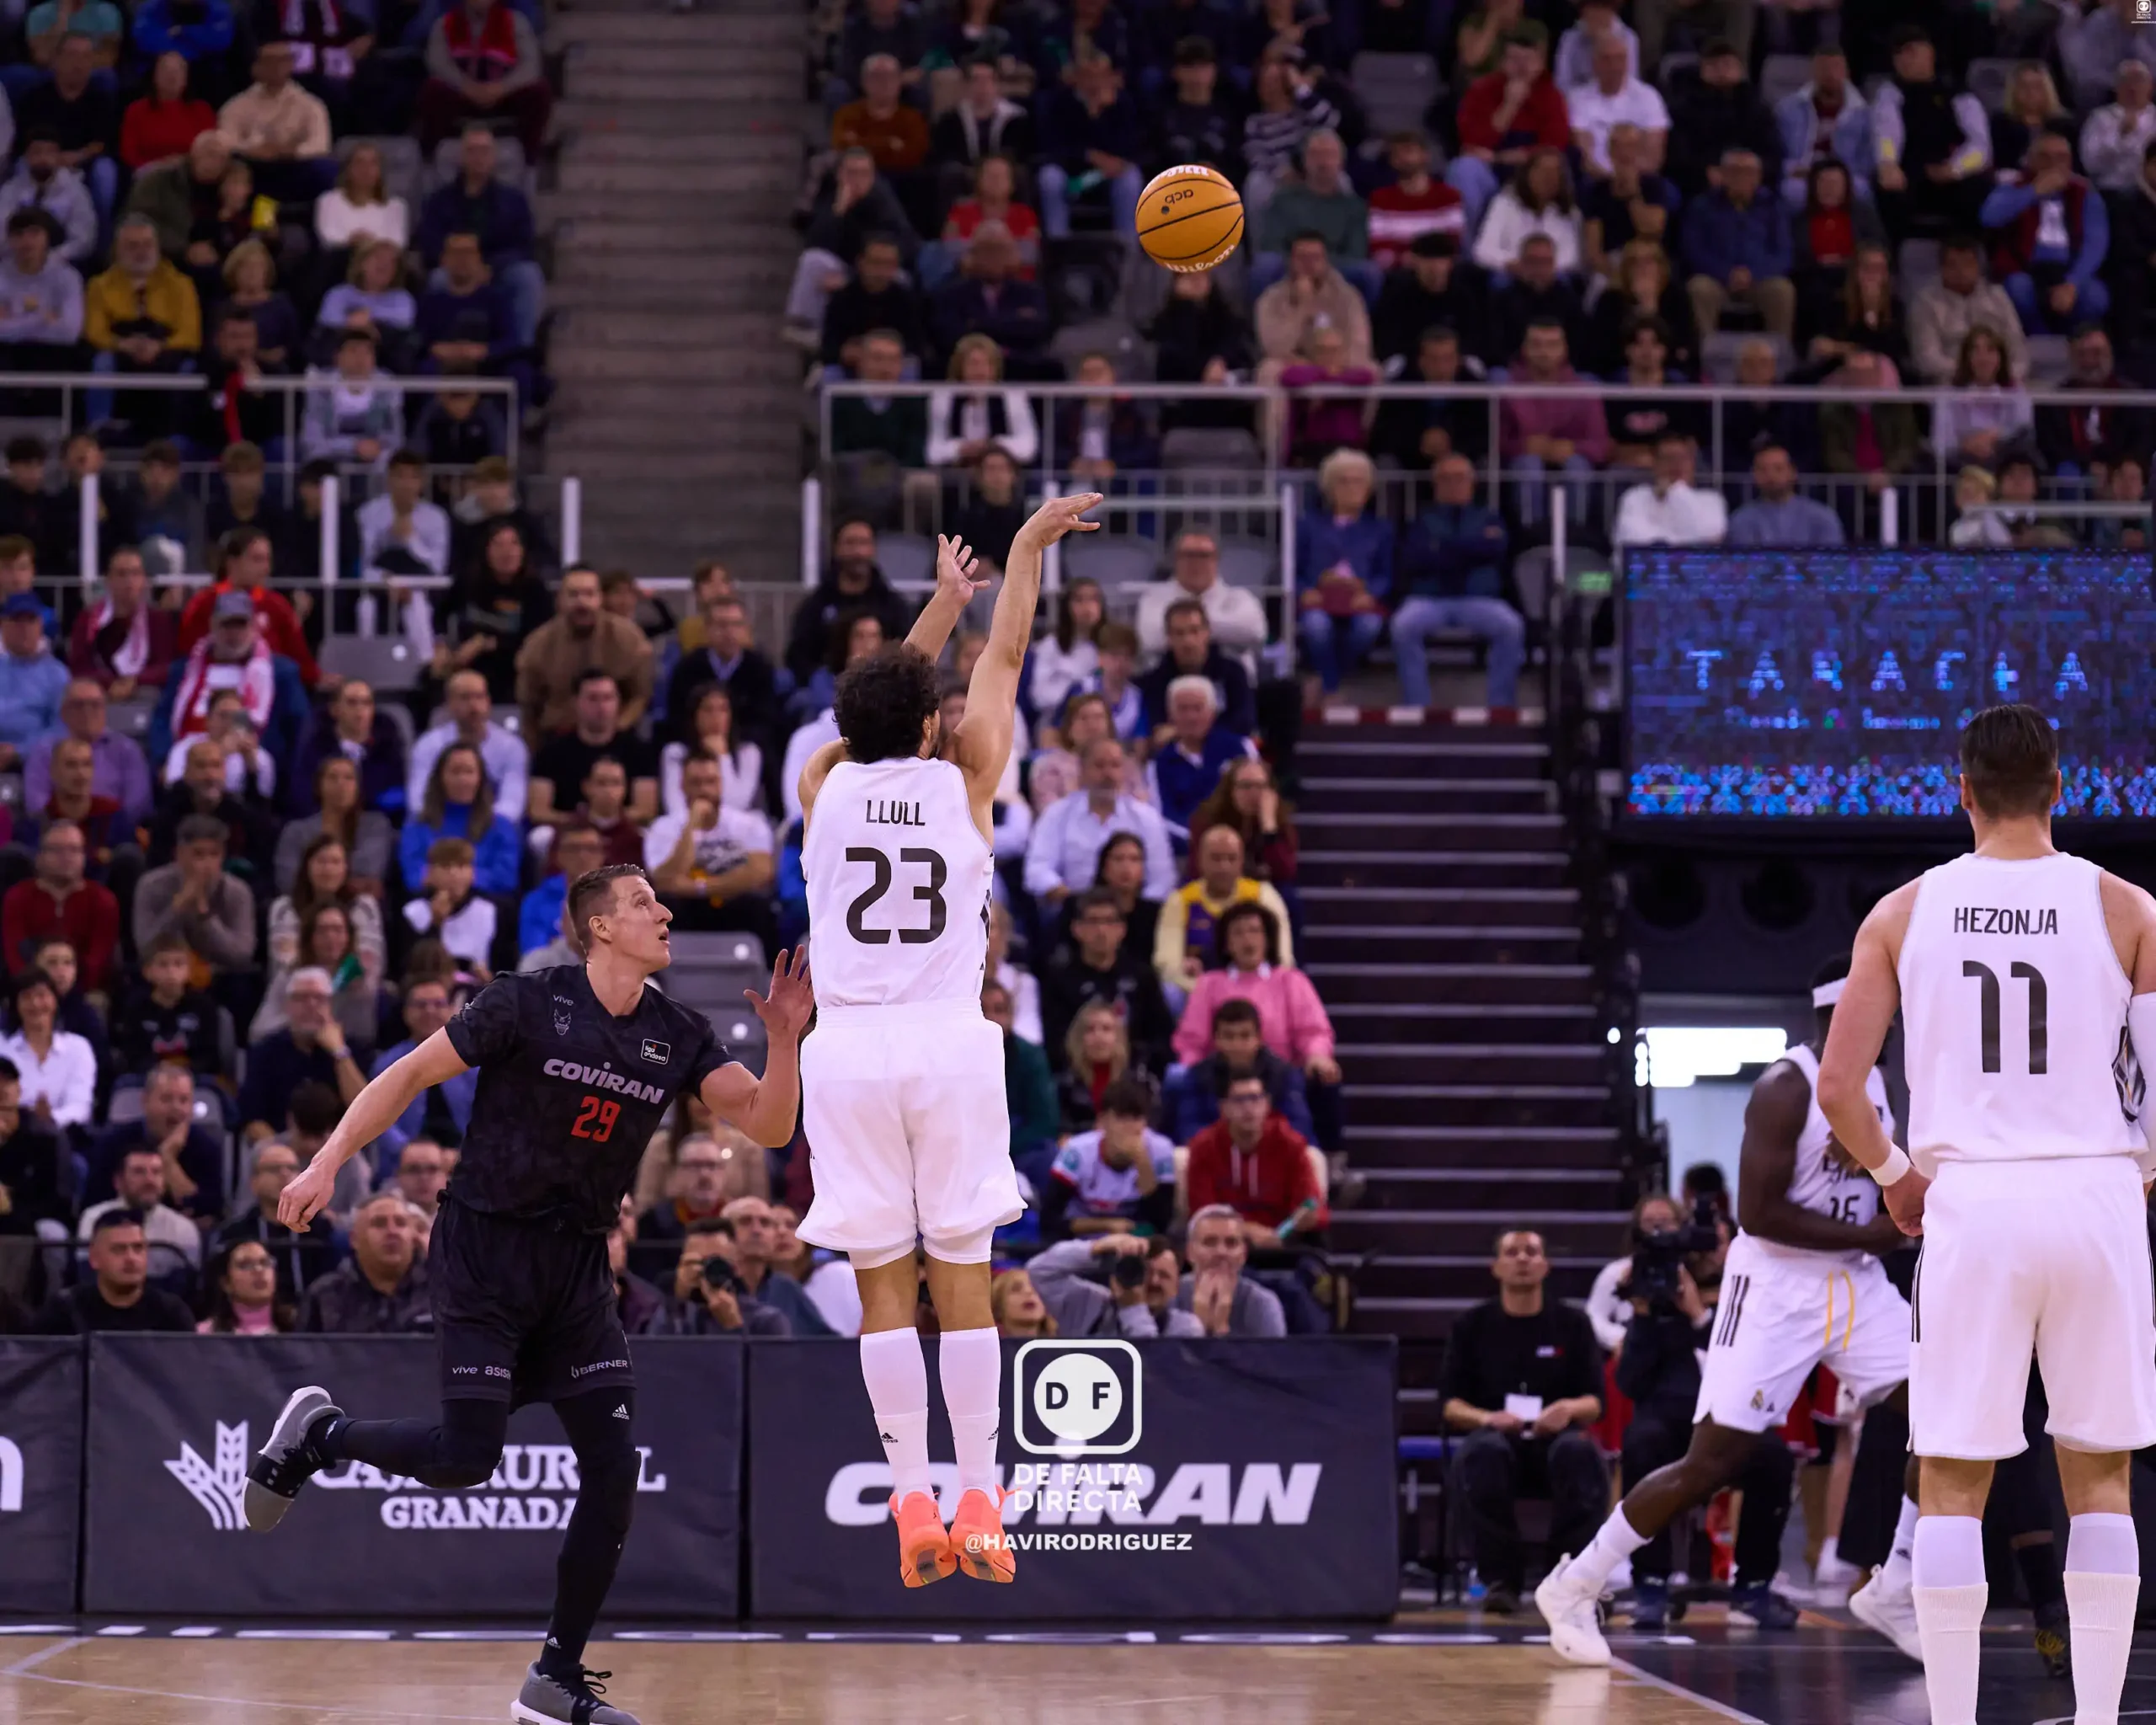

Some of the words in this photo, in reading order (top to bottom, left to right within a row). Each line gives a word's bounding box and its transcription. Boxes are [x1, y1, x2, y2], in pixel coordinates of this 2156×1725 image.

[1164, 188, 1194, 205] acb
[866, 799, 926, 826] LLULL
[846, 846, 947, 944] 23
[1954, 907, 2058, 935] HEZONJA
[552, 994, 574, 1007] vive
[1962, 960, 2047, 1075] 11
[570, 1095, 622, 1143] 29
[452, 1365, 478, 1375] vive
[579, 1359, 628, 1375] BERNER
